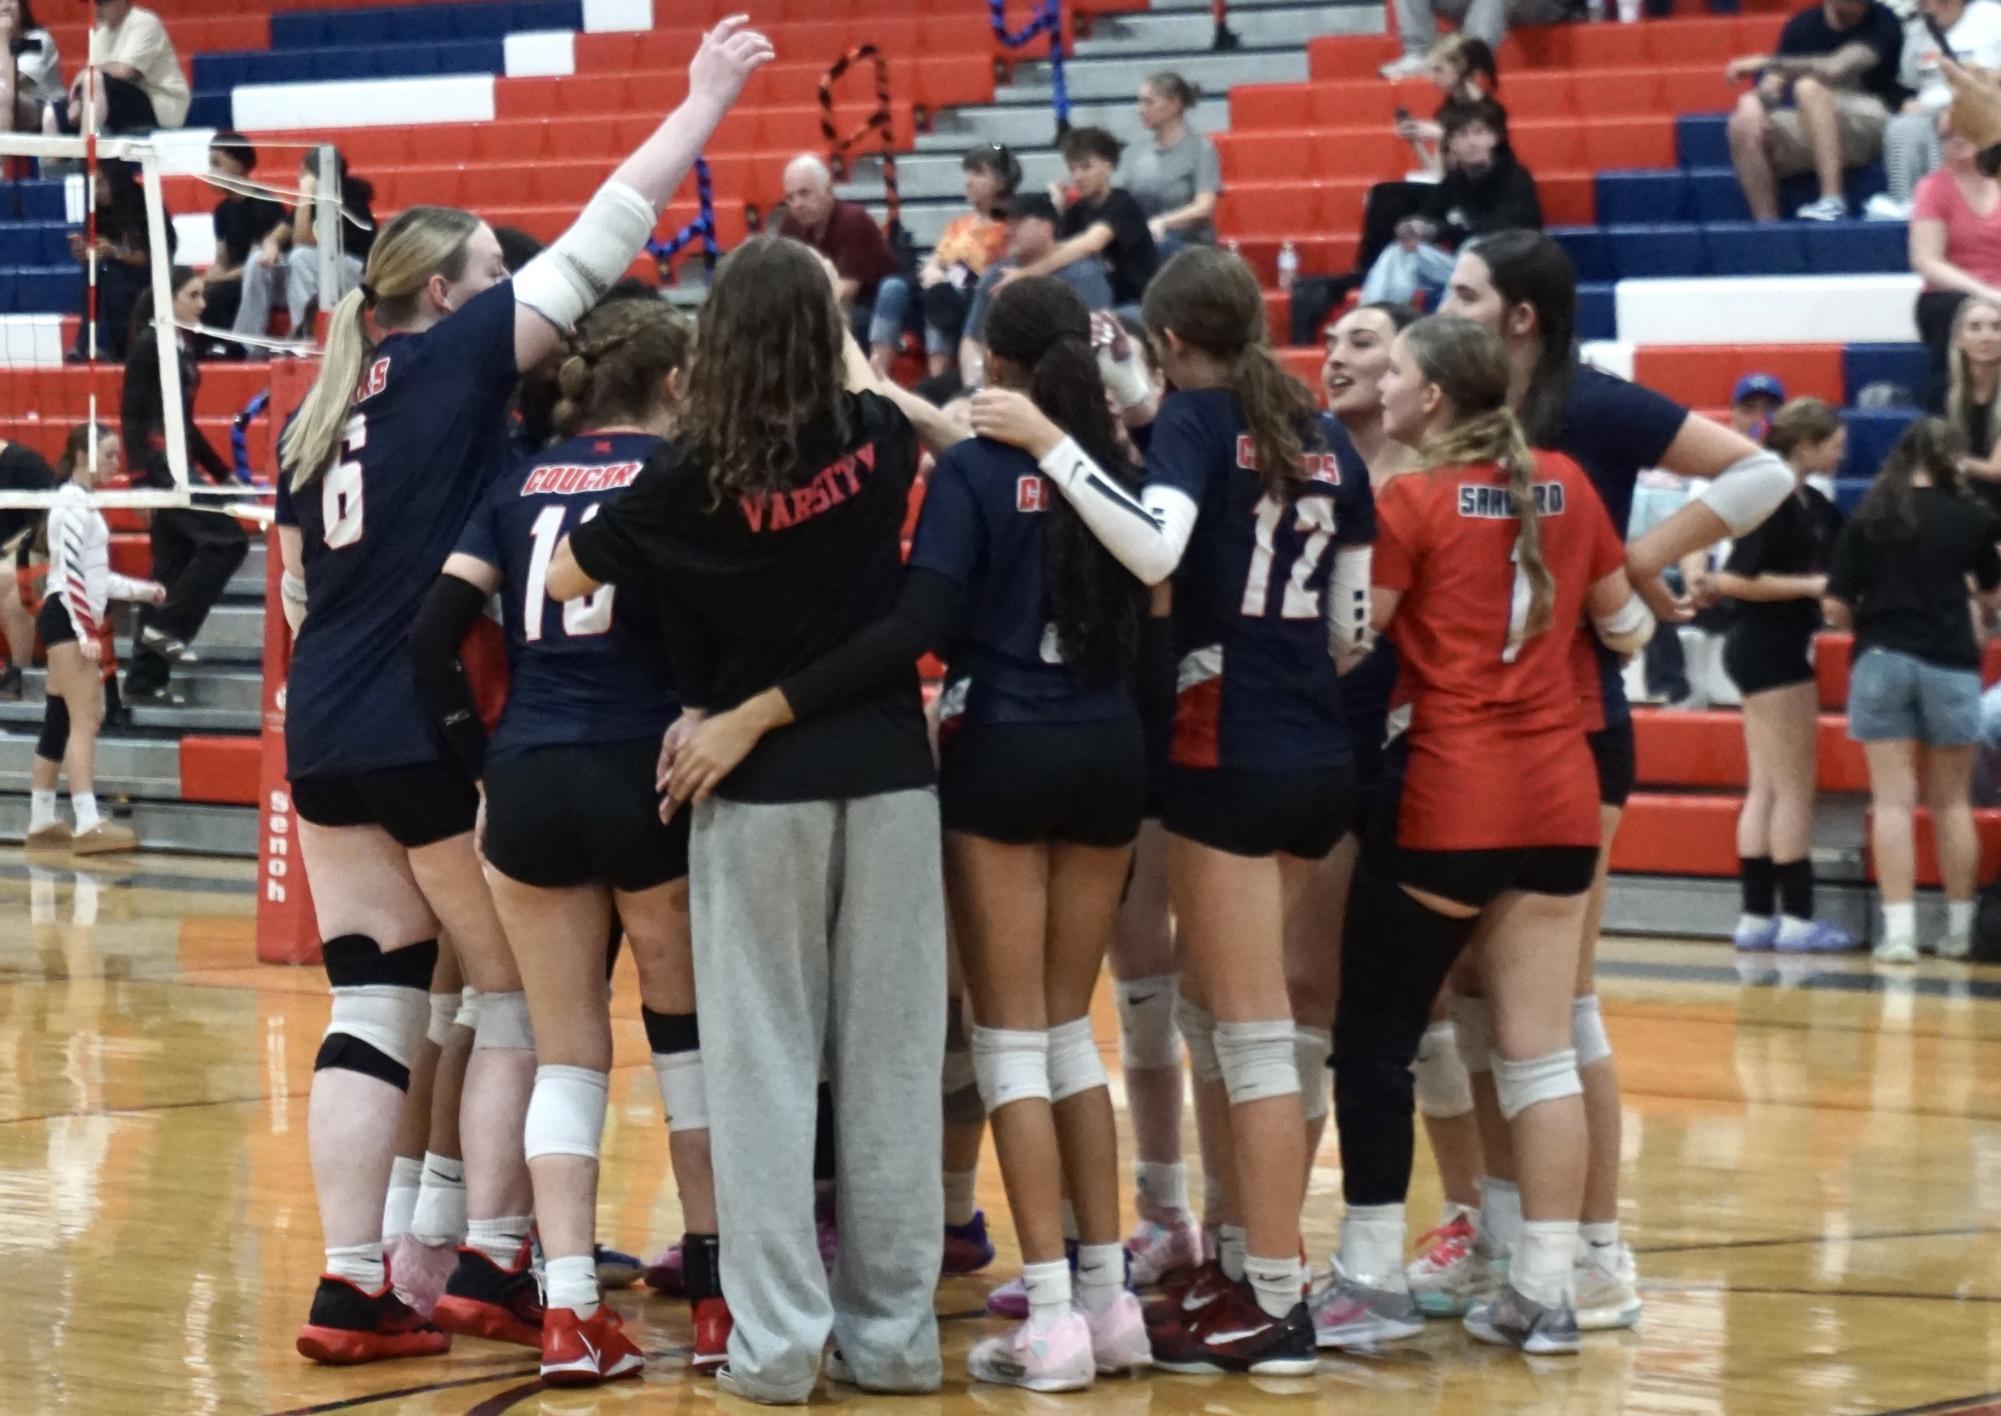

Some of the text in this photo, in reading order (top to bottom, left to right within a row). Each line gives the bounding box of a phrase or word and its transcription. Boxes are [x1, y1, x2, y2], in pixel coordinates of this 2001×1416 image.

[322, 412, 367, 550] 6
[520, 460, 645, 497] COUGAR
[1458, 477, 1565, 519] SANRD
[1241, 492, 1336, 619] 12
[267, 790, 289, 903] senoh
